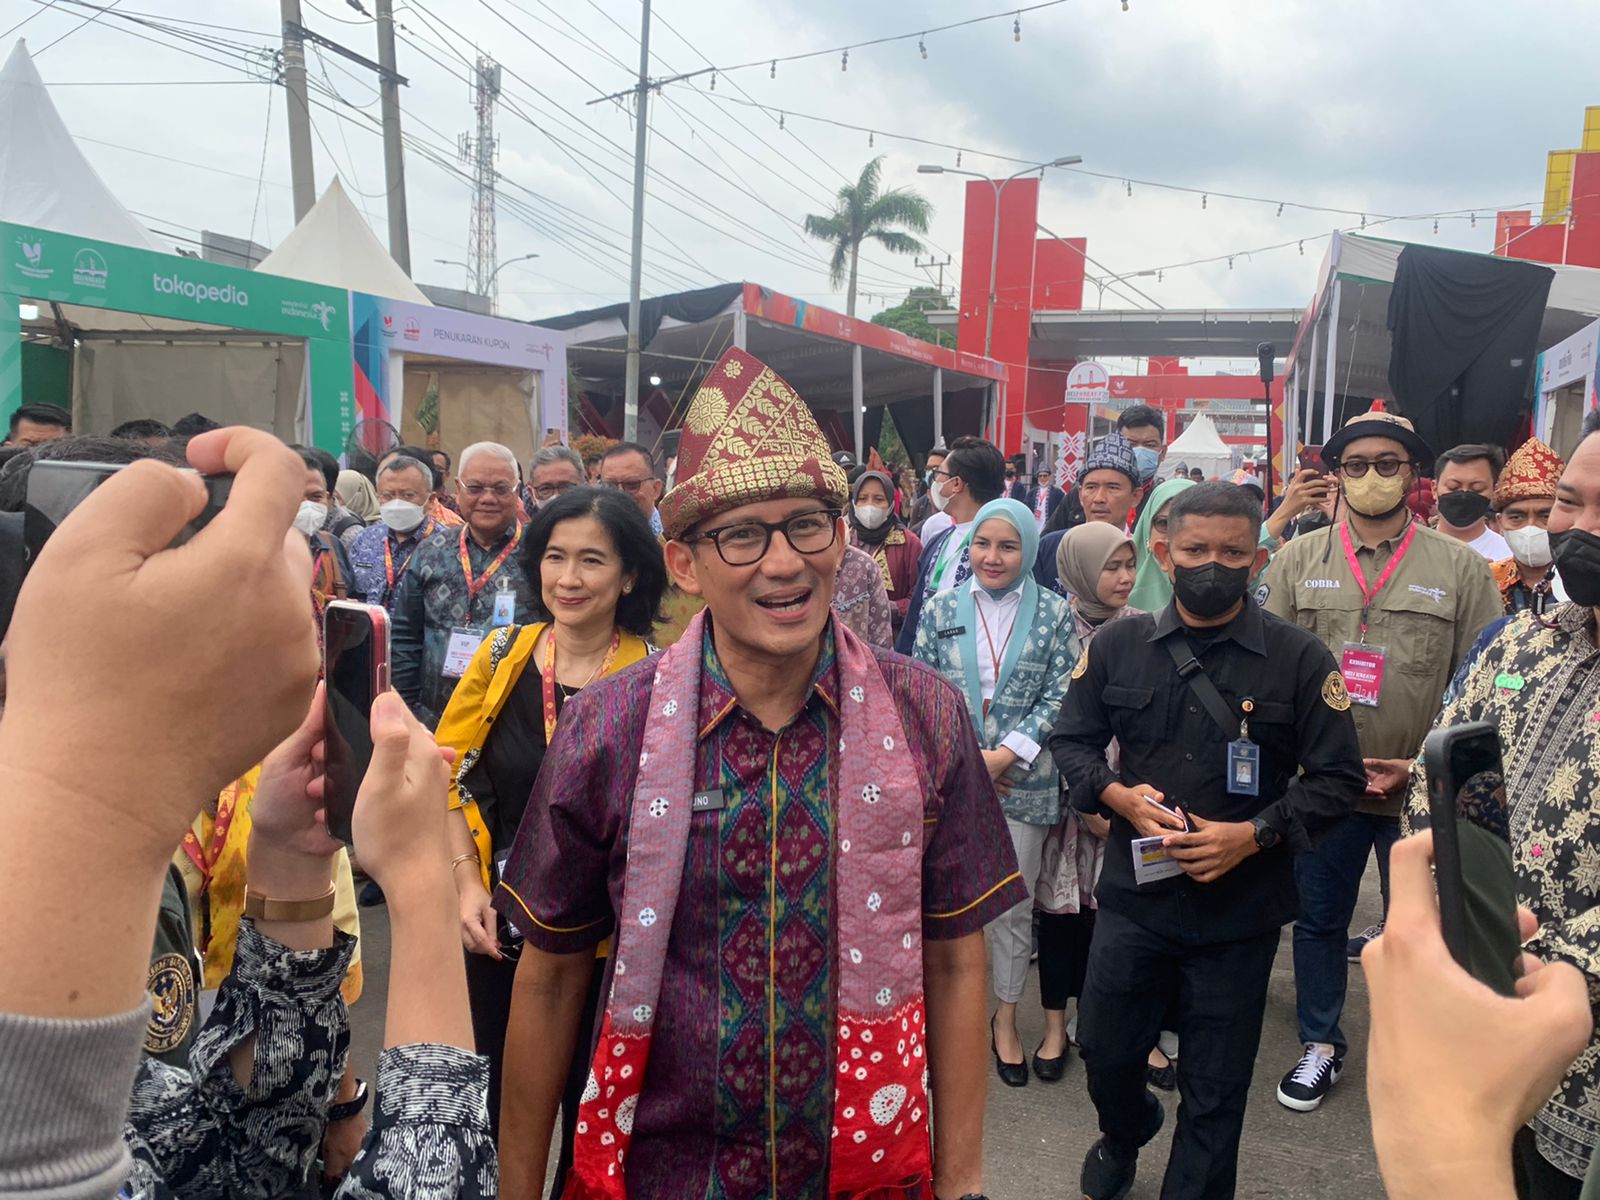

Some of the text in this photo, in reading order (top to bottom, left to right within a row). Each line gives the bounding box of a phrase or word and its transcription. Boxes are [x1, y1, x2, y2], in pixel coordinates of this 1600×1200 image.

[153, 273, 248, 306] tokopedia
[433, 328, 483, 345] PENUKARAN
[484, 338, 510, 350] KUPON
[1304, 579, 1341, 589] COBRA
